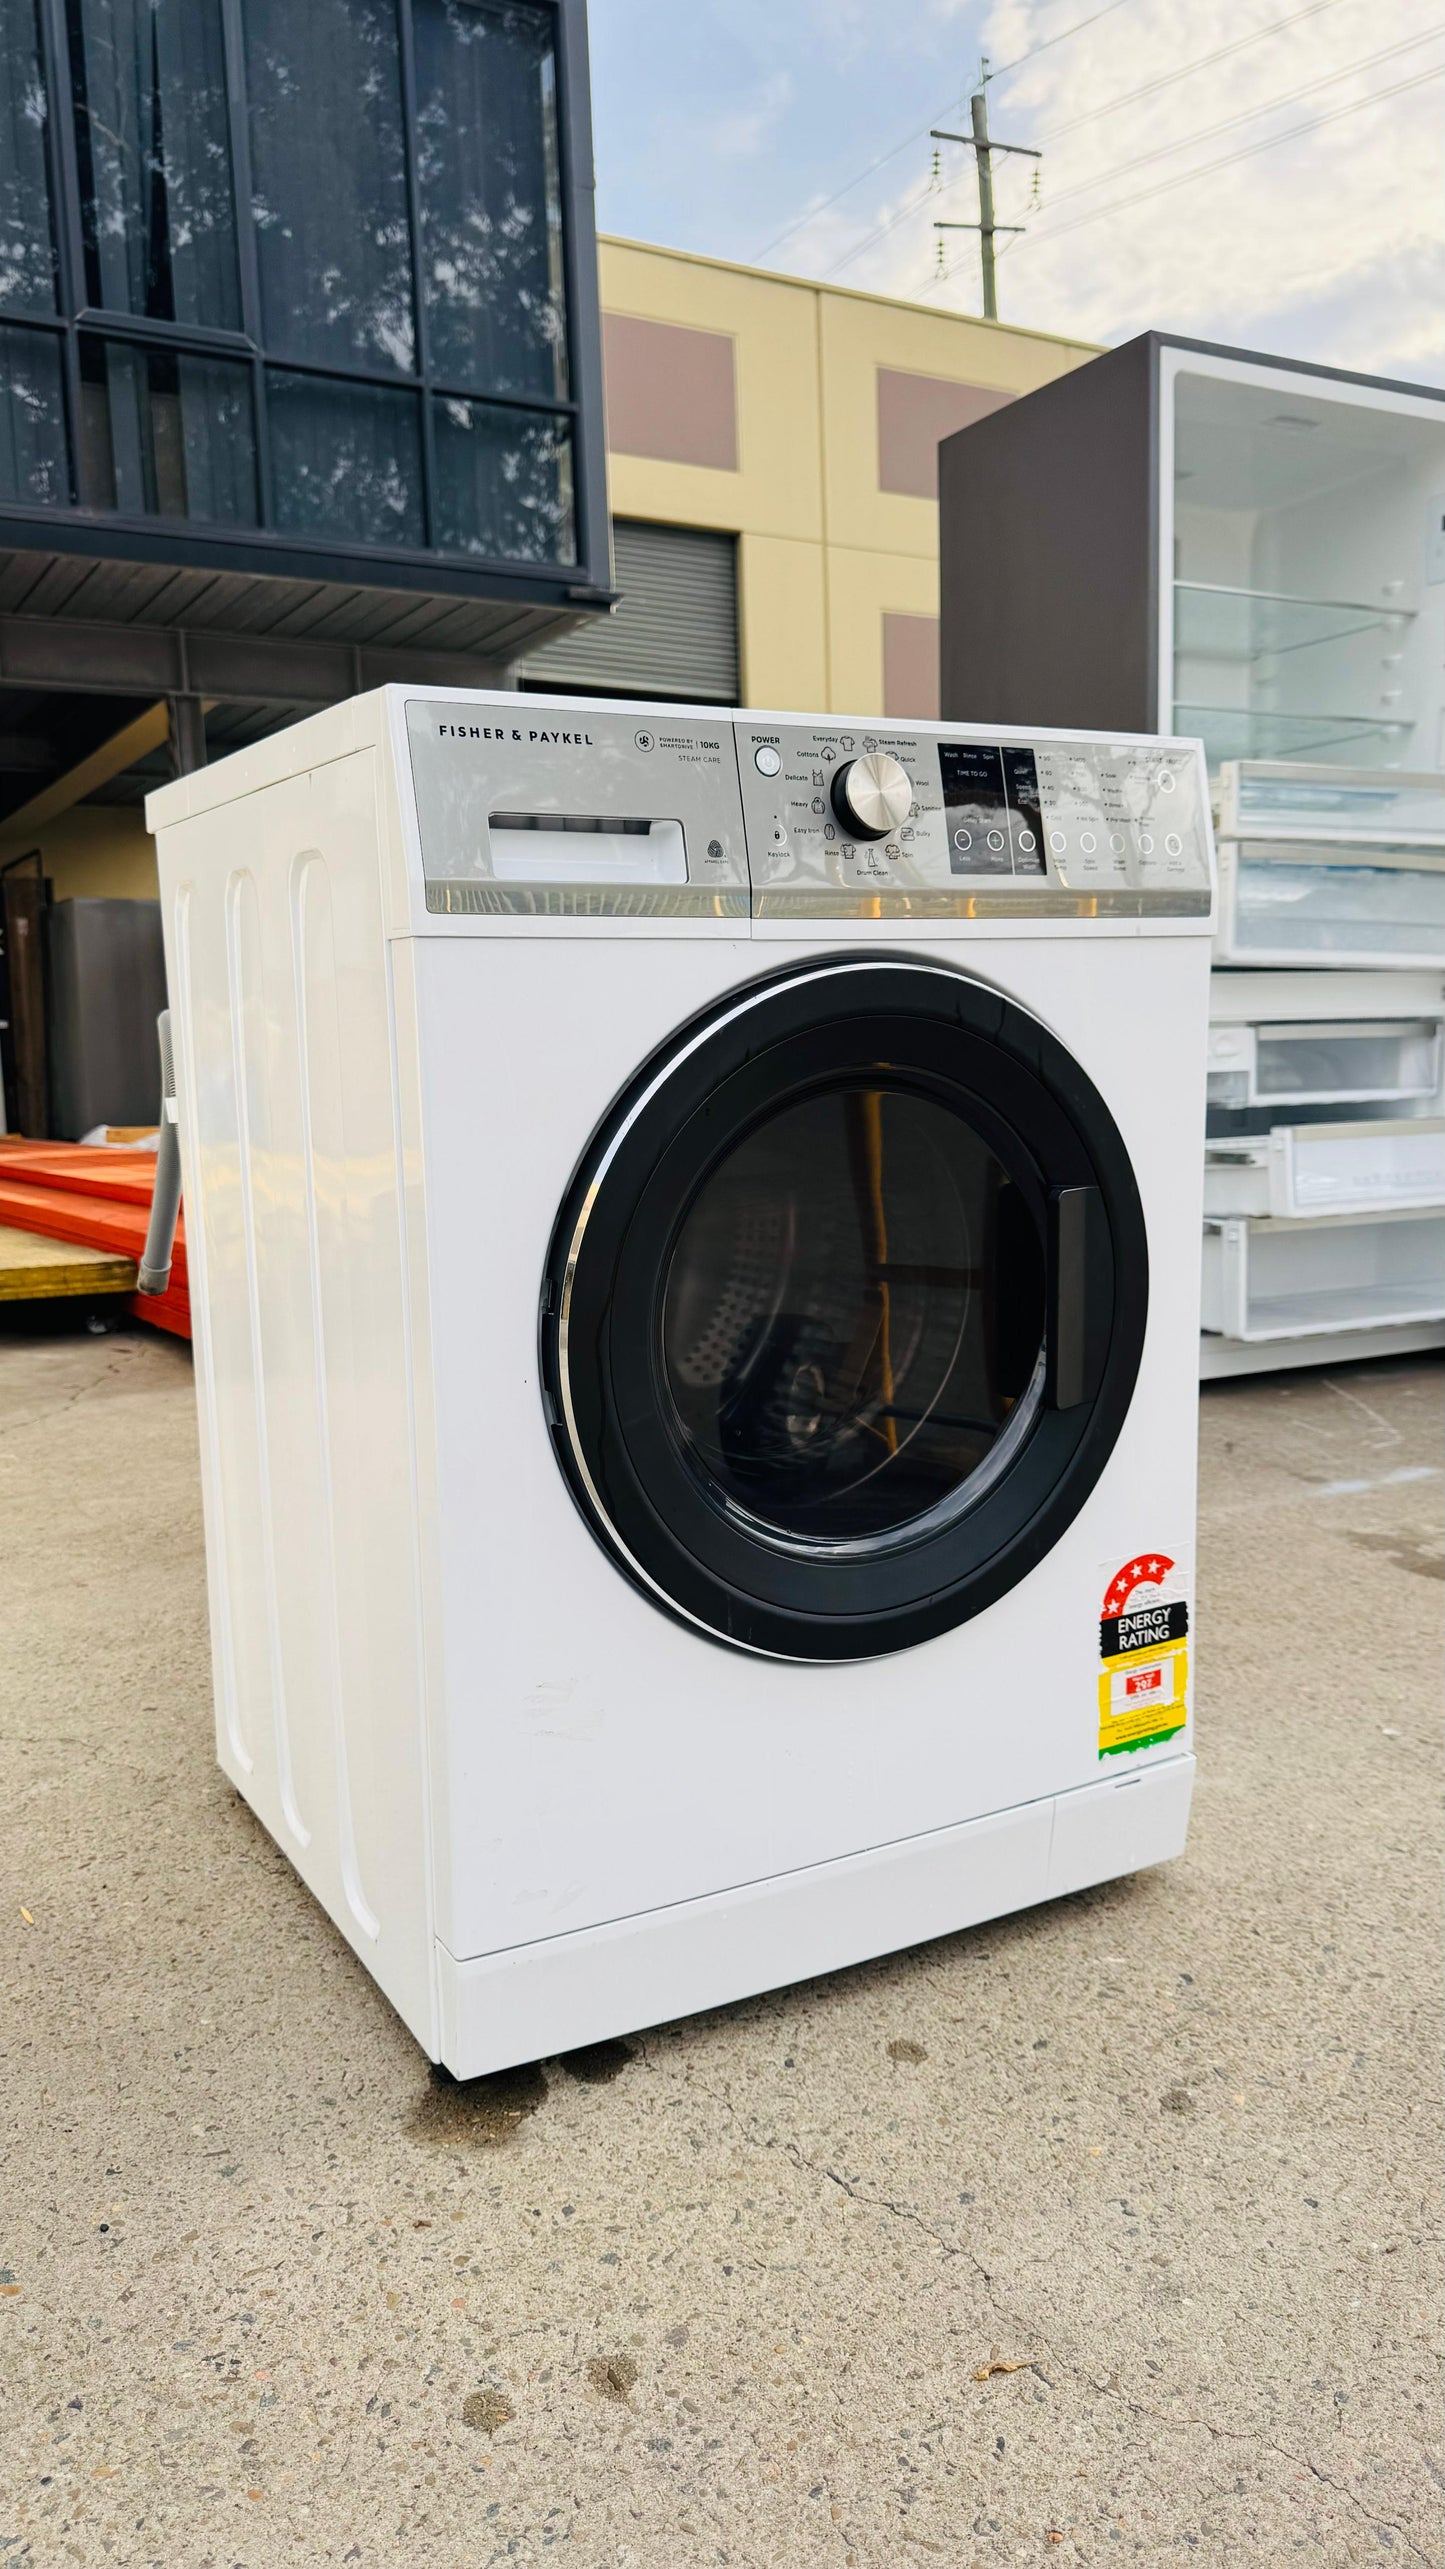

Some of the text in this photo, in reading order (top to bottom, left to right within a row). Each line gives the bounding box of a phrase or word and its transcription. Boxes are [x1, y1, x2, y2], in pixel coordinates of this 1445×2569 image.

[439, 725, 593, 745] FISHER & PAYKEL
[812, 735, 838, 743] Everyday
[751, 736, 780, 744] POWER
[700, 741, 720, 750] 10KG
[703, 756, 721, 764] CARE
[1118, 1607, 1171, 1634] ENERGY
[1119, 1624, 1170, 1650] RATING
